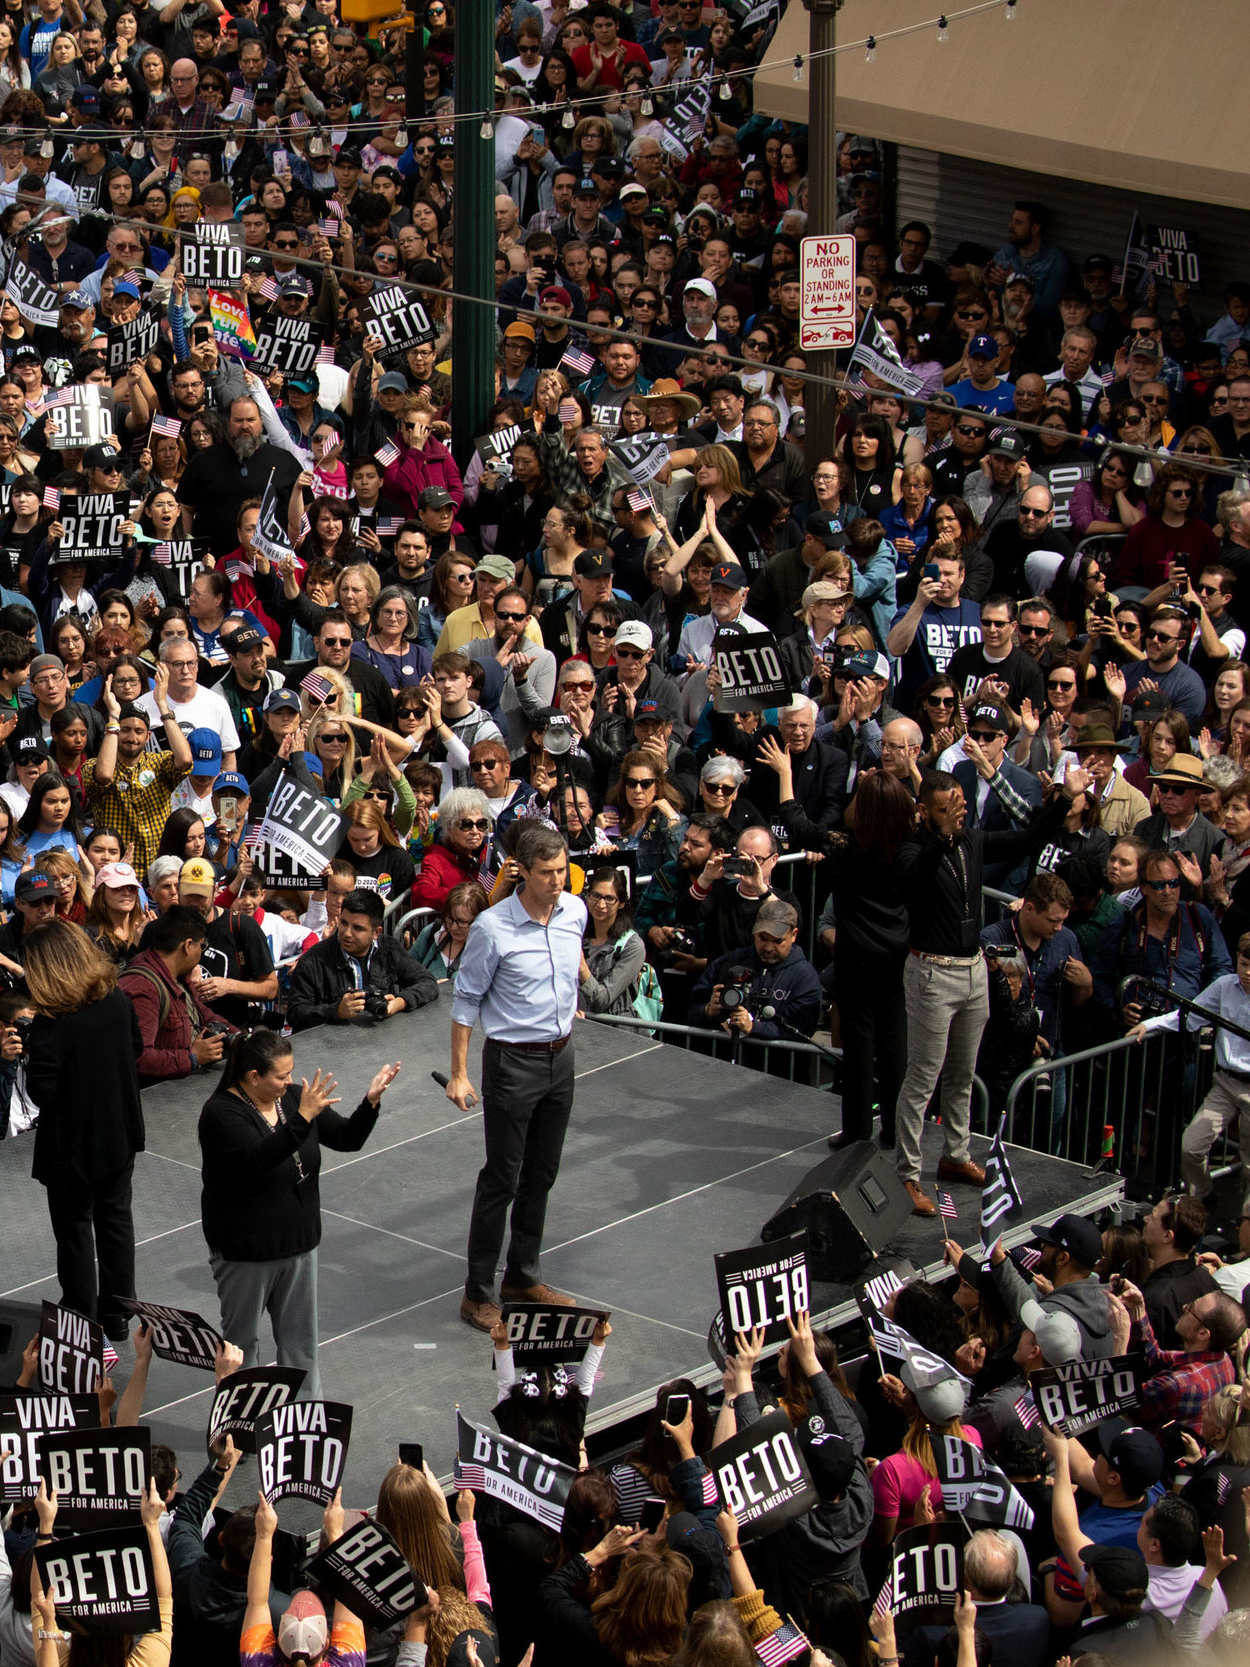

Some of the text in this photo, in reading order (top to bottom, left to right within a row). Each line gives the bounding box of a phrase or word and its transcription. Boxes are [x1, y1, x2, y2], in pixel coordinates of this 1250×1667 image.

[195, 224, 231, 245] VIVA
[817, 242, 840, 256] NO
[1158, 227, 1188, 250] VIVA
[183, 246, 240, 278] BETO
[806, 257, 850, 269] PARKING
[821, 268, 835, 280] OR
[14, 261, 58, 309] BETO
[193, 279, 205, 287] FOR
[806, 279, 851, 292] STANDING
[368, 286, 408, 315] VIVA
[122, 310, 152, 339] VIVA
[274, 317, 311, 341] VIVA
[365, 302, 431, 345] BETO
[16, 344, 35, 356] BETO
[110, 322, 159, 371] BETO
[254, 333, 316, 371] BETO
[387, 335, 425, 355] FOR AMERICA
[879, 362, 906, 383] AMERICA
[54, 406, 113, 438] BETO
[488, 424, 522, 454] VIVA
[77, 494, 115, 515] VIVA
[60, 515, 125, 549] BETO
[71, 547, 110, 558] FOR AMERICA
[592, 554, 603, 566] V
[719, 567, 731, 578] V
[236, 629, 260, 643] BETO
[926, 623, 982, 649] BETO
[717, 645, 783, 689] BETO
[734, 684, 775, 697] FOR AMERICA
[975, 706, 999, 719] BETO
[20, 737, 37, 750] BETO
[199, 749, 213, 759] BETO
[225, 773, 239, 783] BETO
[272, 781, 338, 846] BETO
[280, 832, 306, 858] AMERICA
[277, 876, 308, 887] AMERICA
[742, 1257, 794, 1281] FOR AMERICA
[727, 1264, 809, 1333] BETO
[864, 1270, 904, 1308] VIVA
[56, 1308, 91, 1353] VIVA
[151, 1316, 219, 1357] BETO
[507, 1312, 598, 1342] BETO
[518, 1340, 574, 1351] FOR AMERICA
[40, 1336, 100, 1393] BETO
[1055, 1358, 1115, 1383] VIVA
[16, 1395, 76, 1429] VIVA
[211, 1382, 290, 1434] BETO
[1039, 1368, 1136, 1428] BETO
[272, 1402, 328, 1437] VIVA
[1067, 1400, 1122, 1432] FOR AMERICA
[48, 1447, 144, 1496] BETO
[260, 1434, 342, 1496] BETO
[472, 1428, 557, 1494] BETO
[718, 1431, 802, 1515] BETO
[21, 1484, 40, 1498] FOR
[70, 1496, 129, 1510] FOR AMERICA
[271, 1481, 321, 1501] FOR AMERICA
[500, 1480, 538, 1511] AMERICA
[746, 1489, 795, 1521] FOR AMERICA
[46, 1546, 149, 1603] BETO
[335, 1527, 416, 1610] BETO
[893, 1543, 958, 1604] ETO
[338, 1562, 382, 1609] FOR AMERICA
[72, 1599, 132, 1617] FOR AMERICA
[901, 1593, 940, 1612] AMERICA
